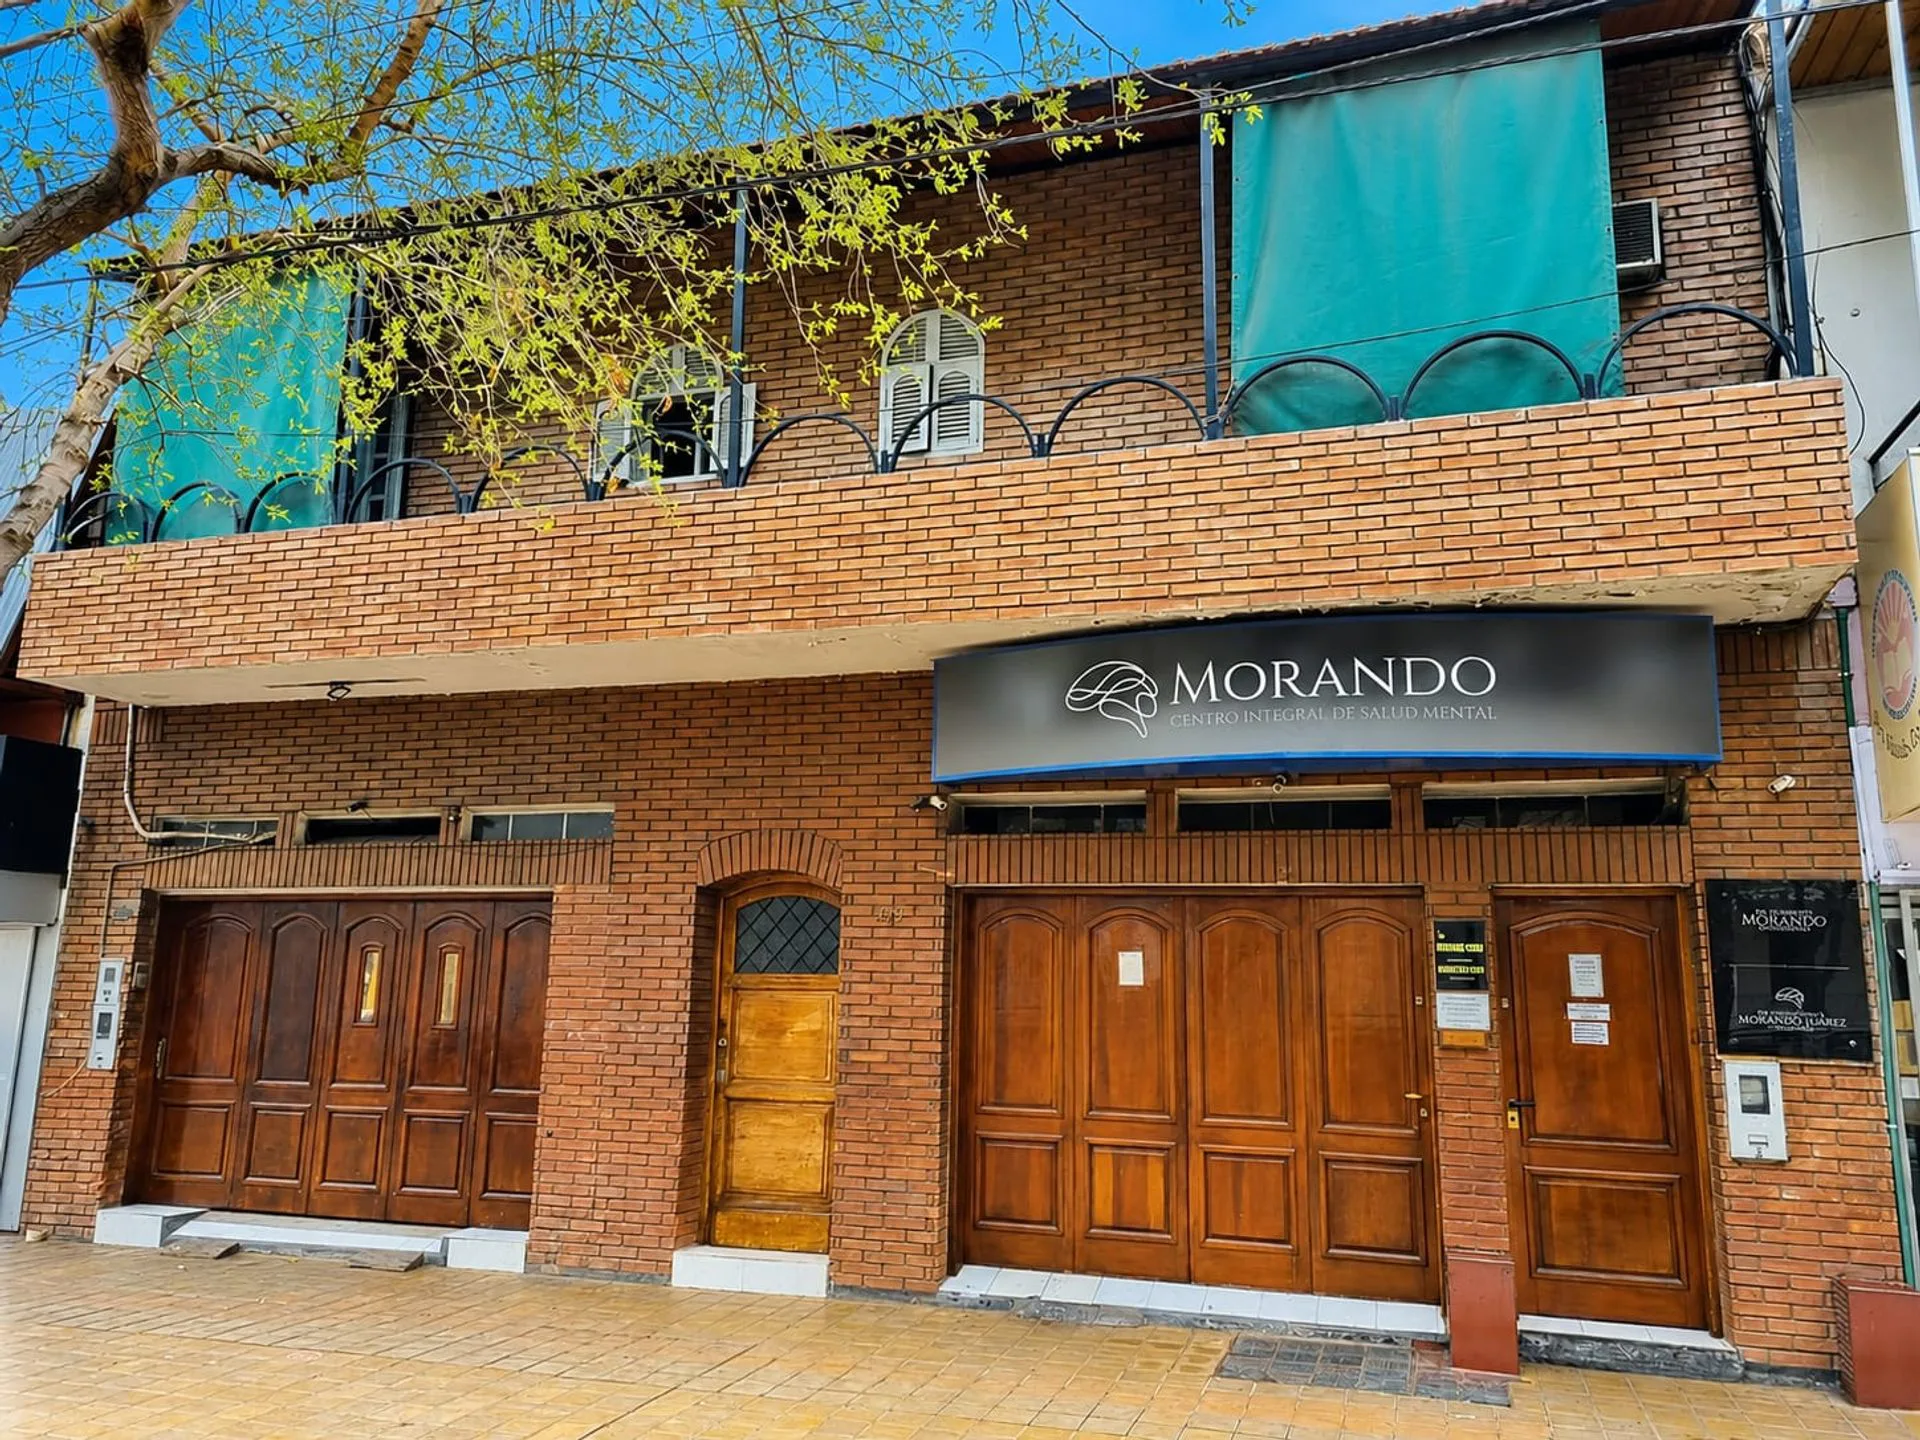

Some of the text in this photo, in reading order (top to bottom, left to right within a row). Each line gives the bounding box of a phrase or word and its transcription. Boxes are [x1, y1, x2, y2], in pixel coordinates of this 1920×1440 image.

[1169, 656, 1497, 705] MORANDO
[1169, 705, 1497, 728] CENTRO INTEGRAL DE SALUD MENTAL
[1741, 912, 1827, 928] MORANDO
[1738, 1014, 1802, 1026] MORANDO
